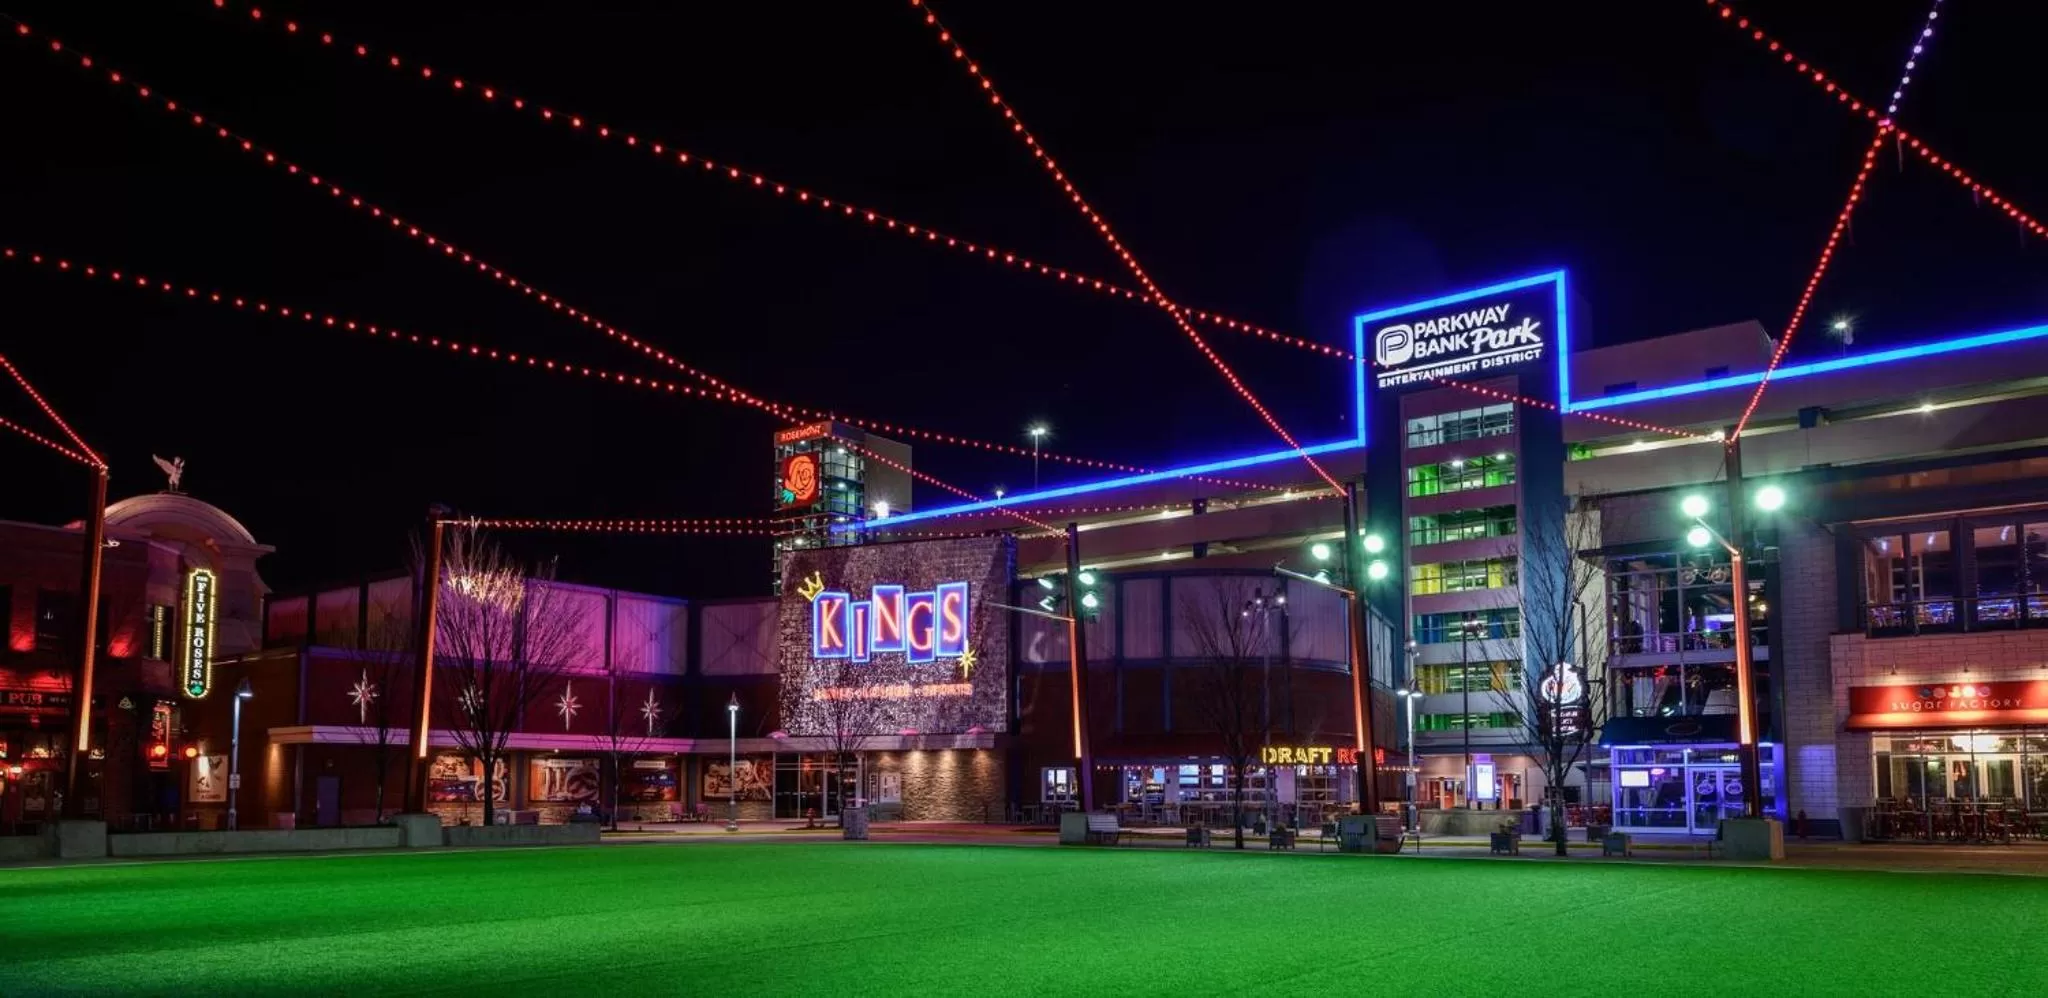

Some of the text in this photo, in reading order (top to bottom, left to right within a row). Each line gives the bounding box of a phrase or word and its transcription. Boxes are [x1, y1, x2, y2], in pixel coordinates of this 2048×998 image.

[1413, 303, 1510, 339] PARKWAY
[1414, 317, 1542, 359] BANK Park
[1378, 348, 1543, 389] ENTERTAINMENT DISTRICT
[196, 582, 207, 624] FIVE
[819, 591, 962, 657] KINGS
[192, 627, 205, 679] ROSES
[1891, 698, 2022, 712] sugar FACTORY
[1262, 746, 1332, 764] DRAFT
